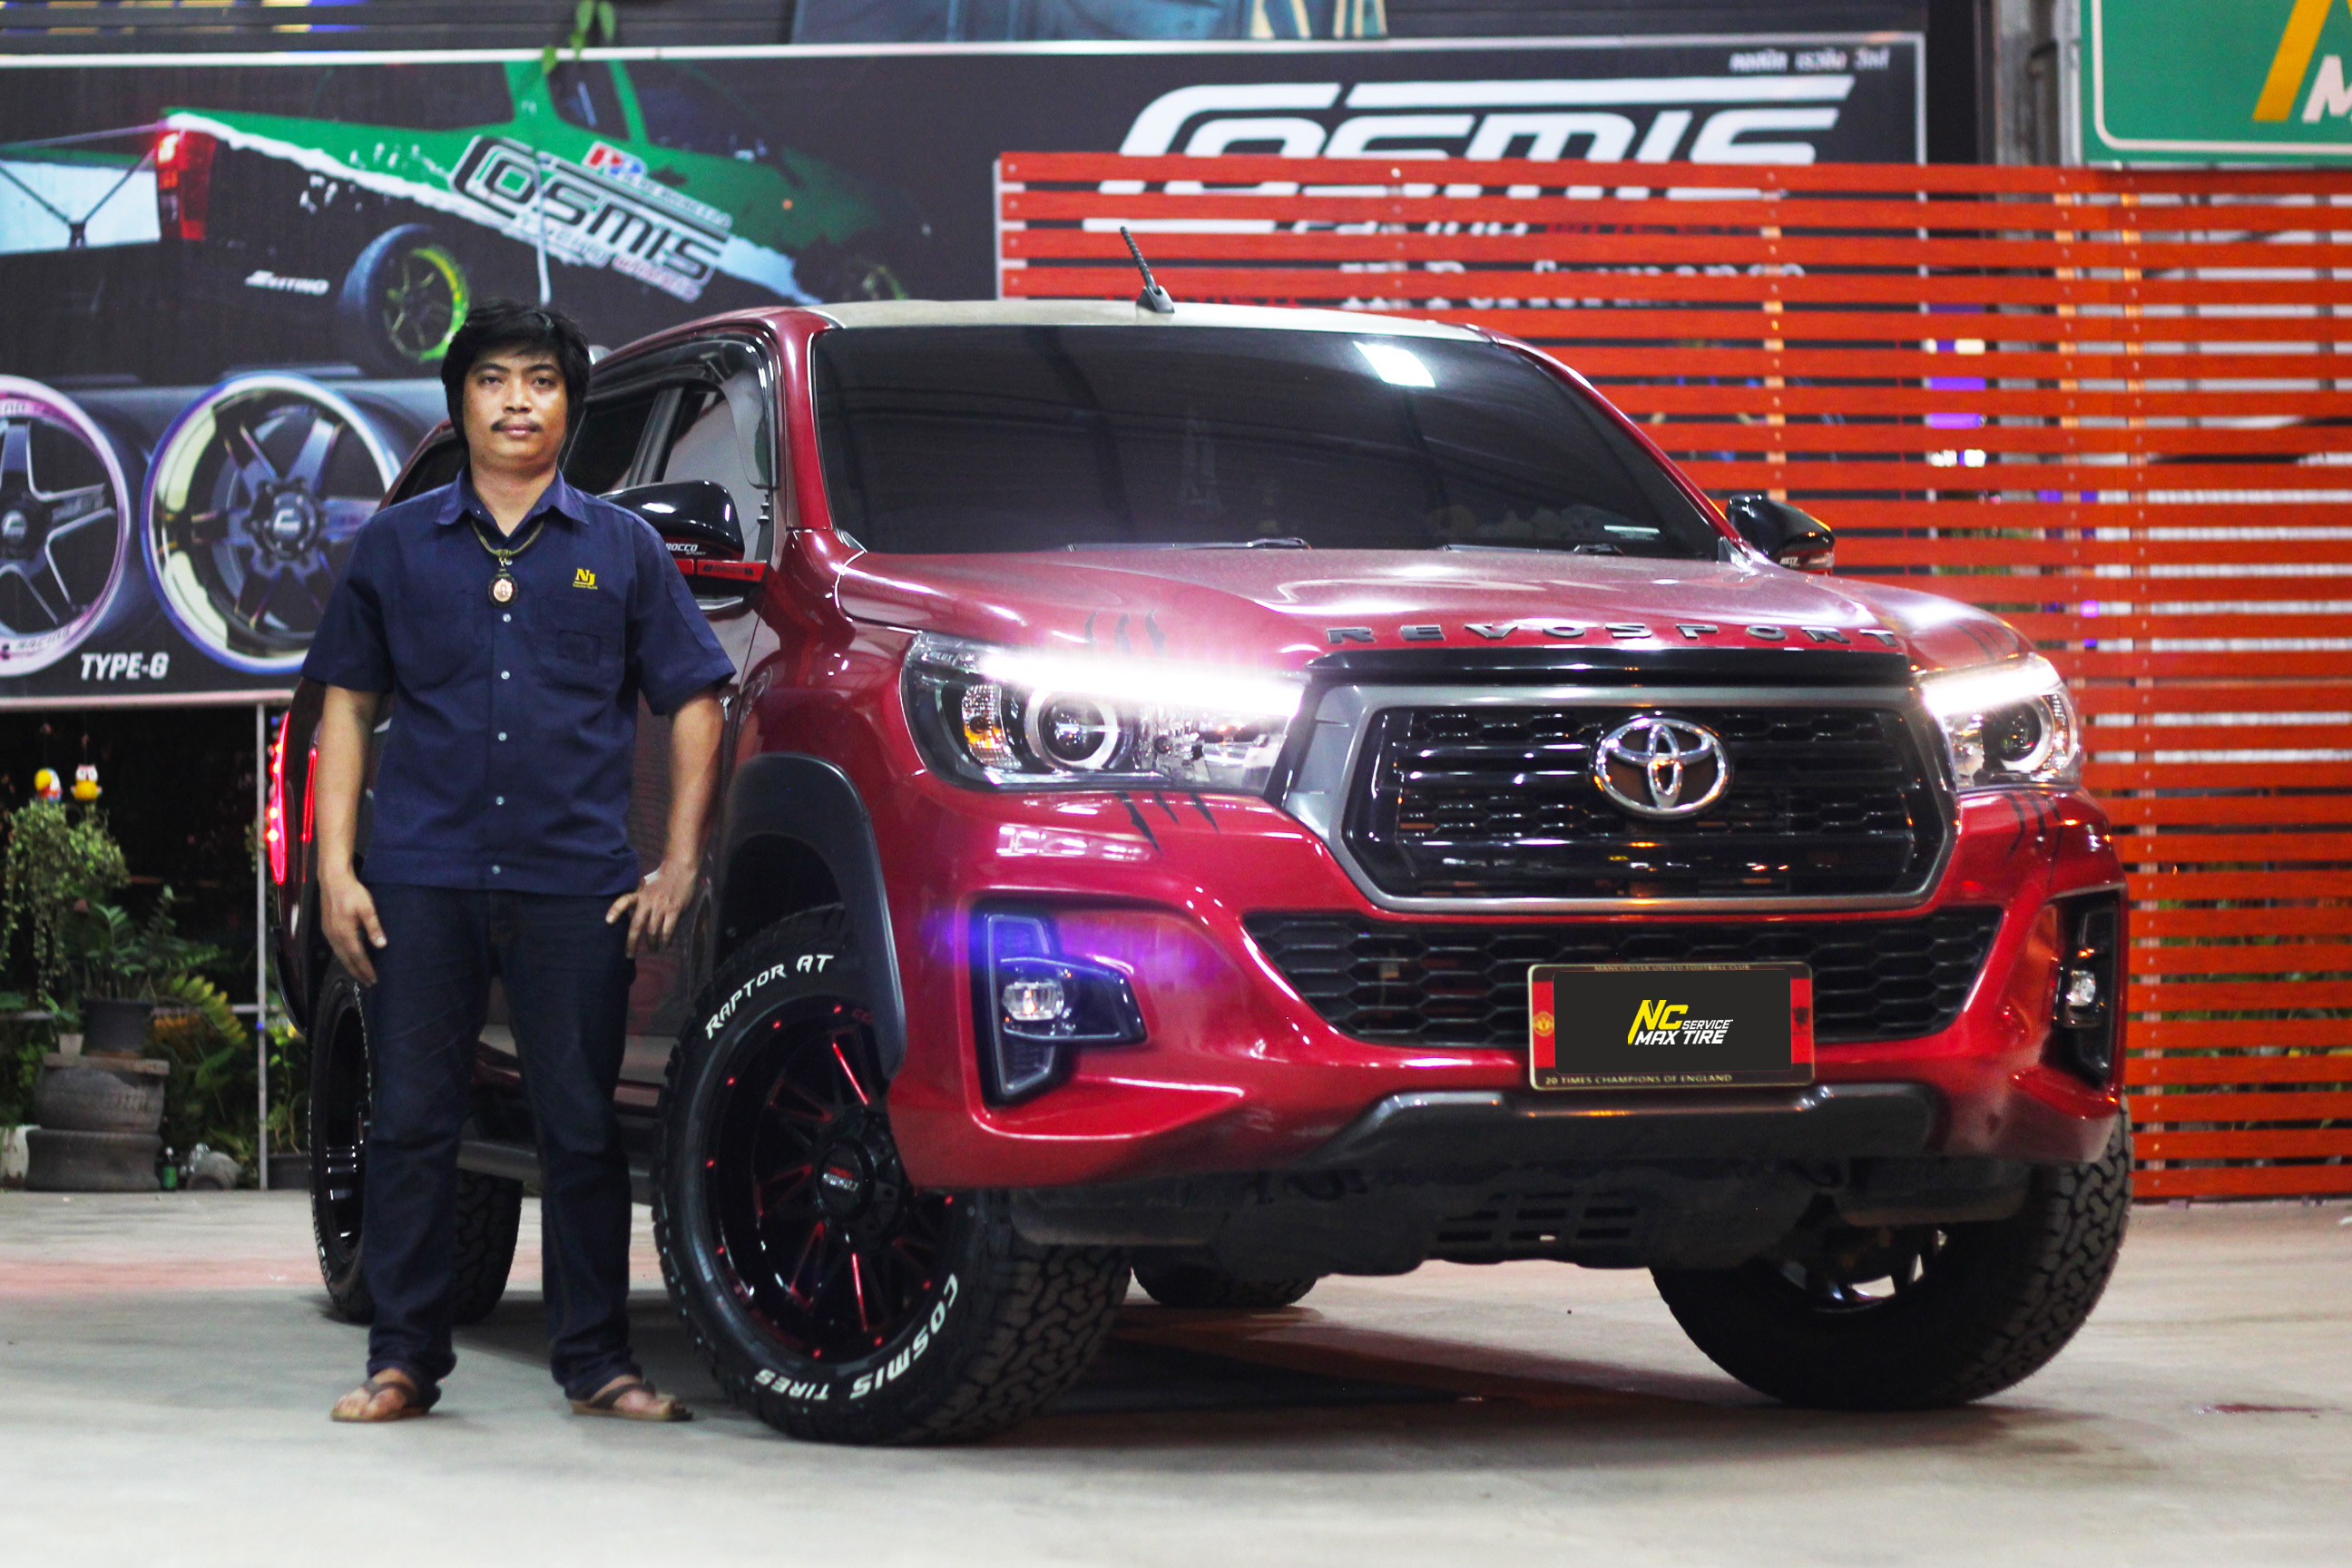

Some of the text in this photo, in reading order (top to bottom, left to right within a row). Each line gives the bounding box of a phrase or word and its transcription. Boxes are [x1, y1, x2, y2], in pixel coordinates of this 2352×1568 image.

[449, 136, 729, 285] COSMIS
[705, 954, 834, 1040] RAPTOR AT
[1545, 1073, 1732, 1085] 20 TIMES CHAMPIONS OF ENGLAND
[849, 1273, 958, 1399] COSMIS
[754, 1368, 829, 1400] TIRES
